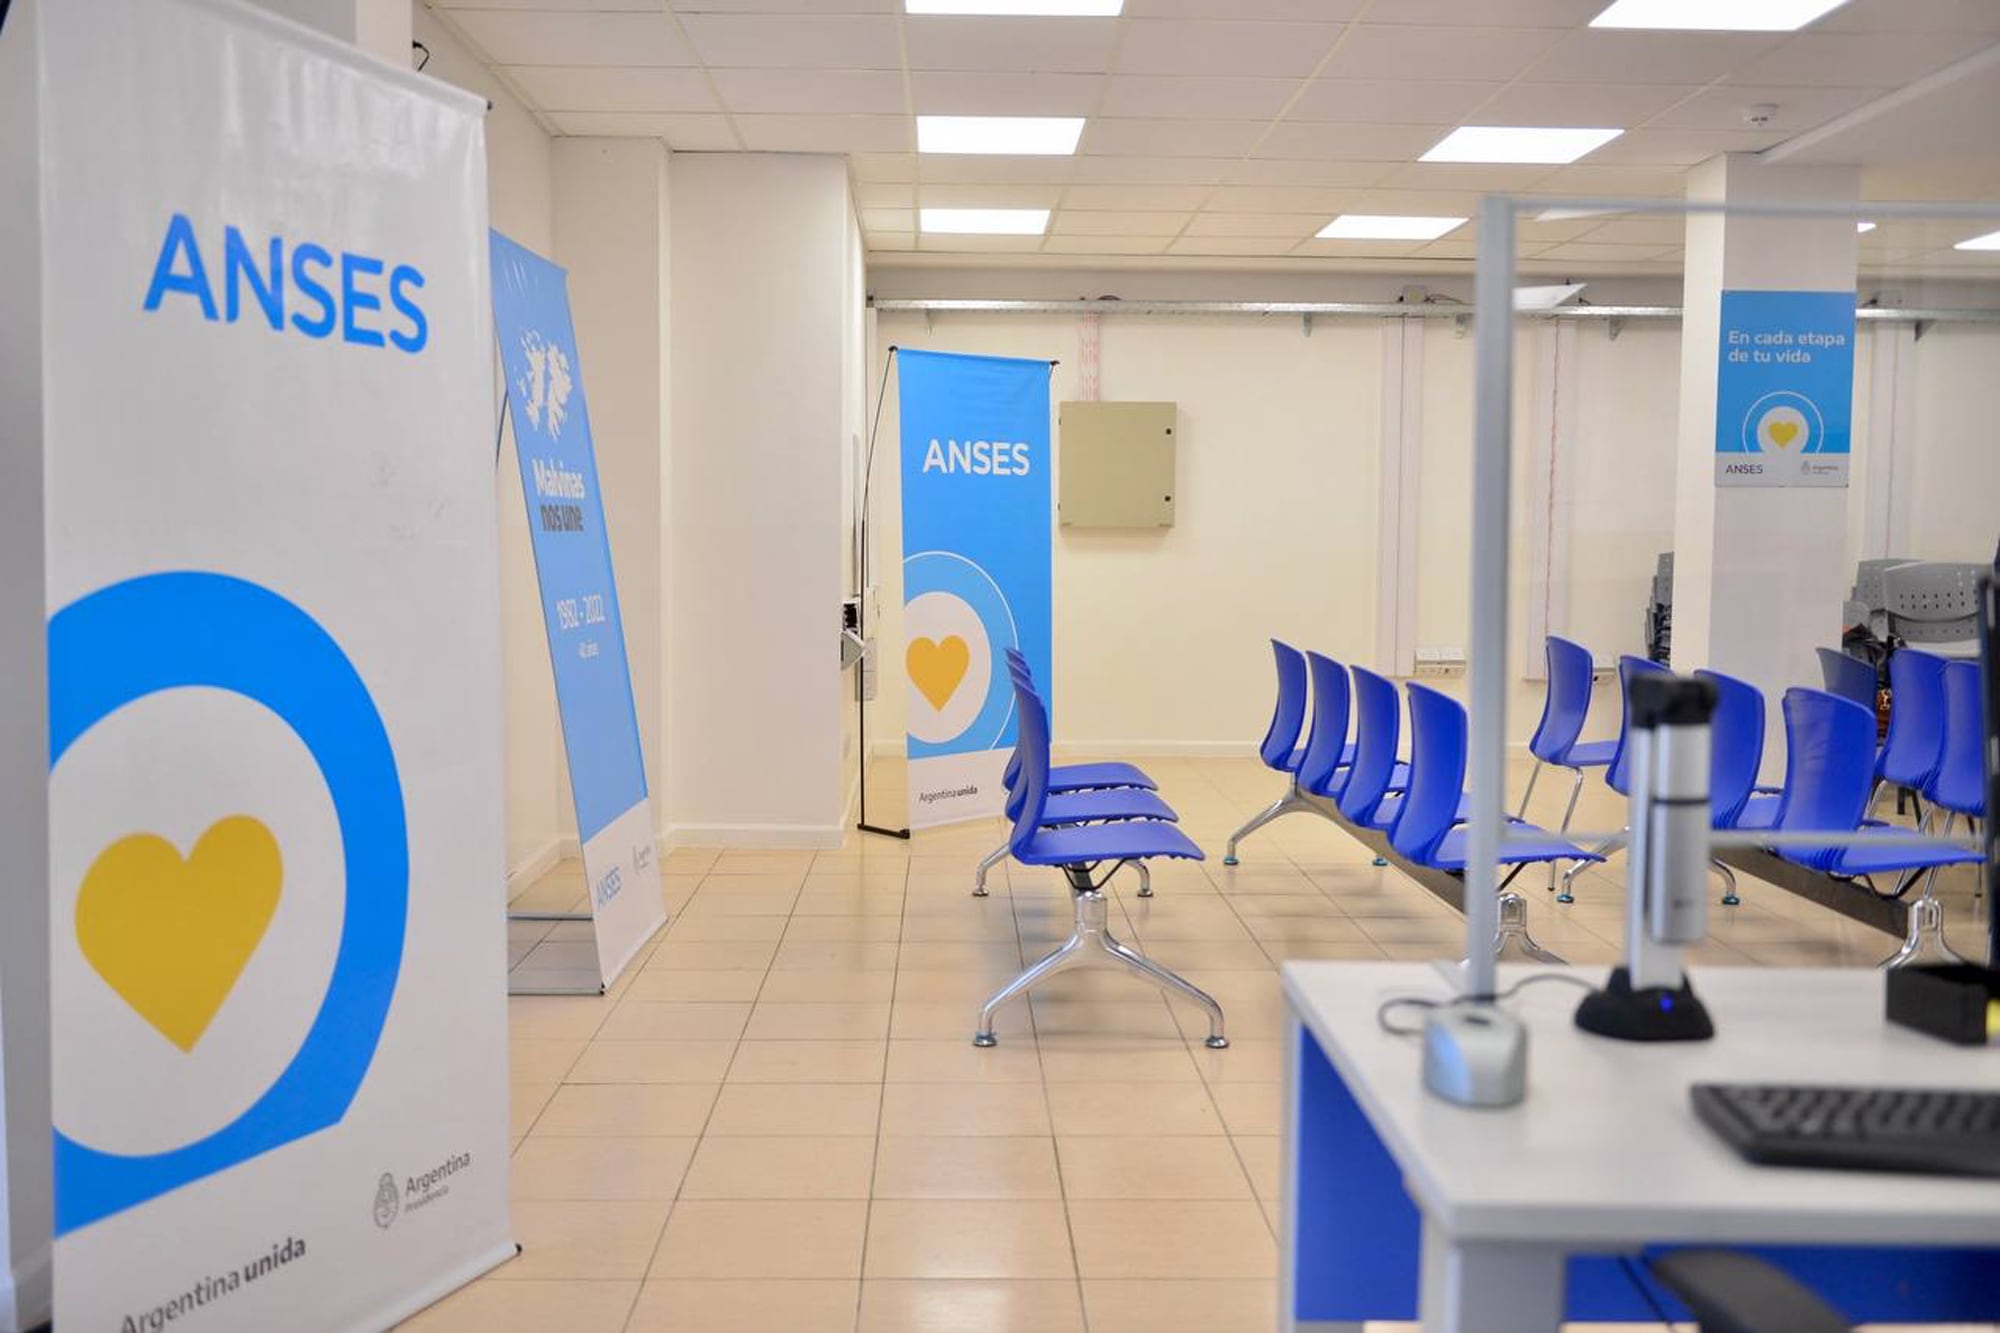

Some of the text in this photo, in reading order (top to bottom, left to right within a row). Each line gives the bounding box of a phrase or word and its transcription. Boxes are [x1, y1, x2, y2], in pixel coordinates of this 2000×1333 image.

[144, 212, 428, 354] ANSES
[1728, 330, 1845, 348] En cada etapa
[1728, 348, 1812, 363] de tu vida
[923, 438, 1030, 476] ANSES
[1725, 464, 1764, 475] ANSES
[532, 458, 585, 499] Malvinas
[540, 503, 584, 532] nos une
[919, 785, 978, 804] Argentina unida
[405, 1152, 471, 1197] Argentina
[121, 1236, 307, 1333] Argentina unida
